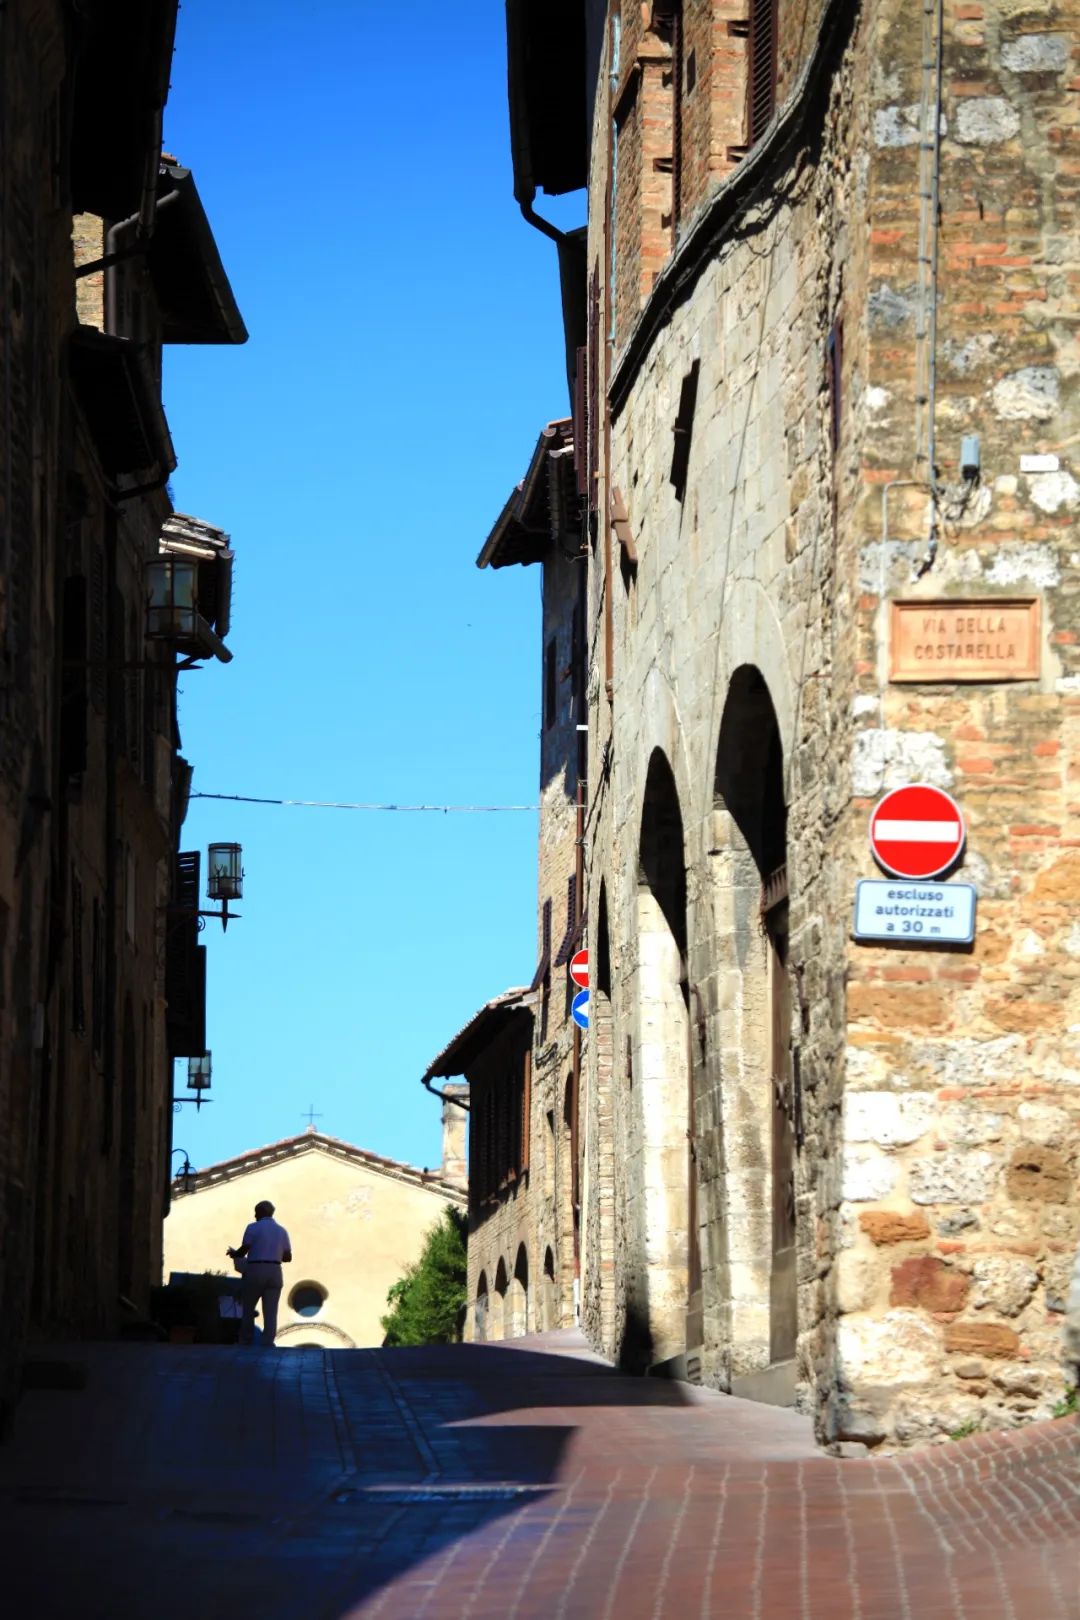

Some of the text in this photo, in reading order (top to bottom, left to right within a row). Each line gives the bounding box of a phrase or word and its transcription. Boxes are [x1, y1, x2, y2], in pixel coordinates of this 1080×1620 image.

[922, 617, 1007, 634] VIA DELLA
[914, 643, 1016, 660] COSTARELLA
[887, 888, 944, 902] escluso
[875, 904, 955, 918] autorizzati
[886, 920, 941, 934] a 30 m
